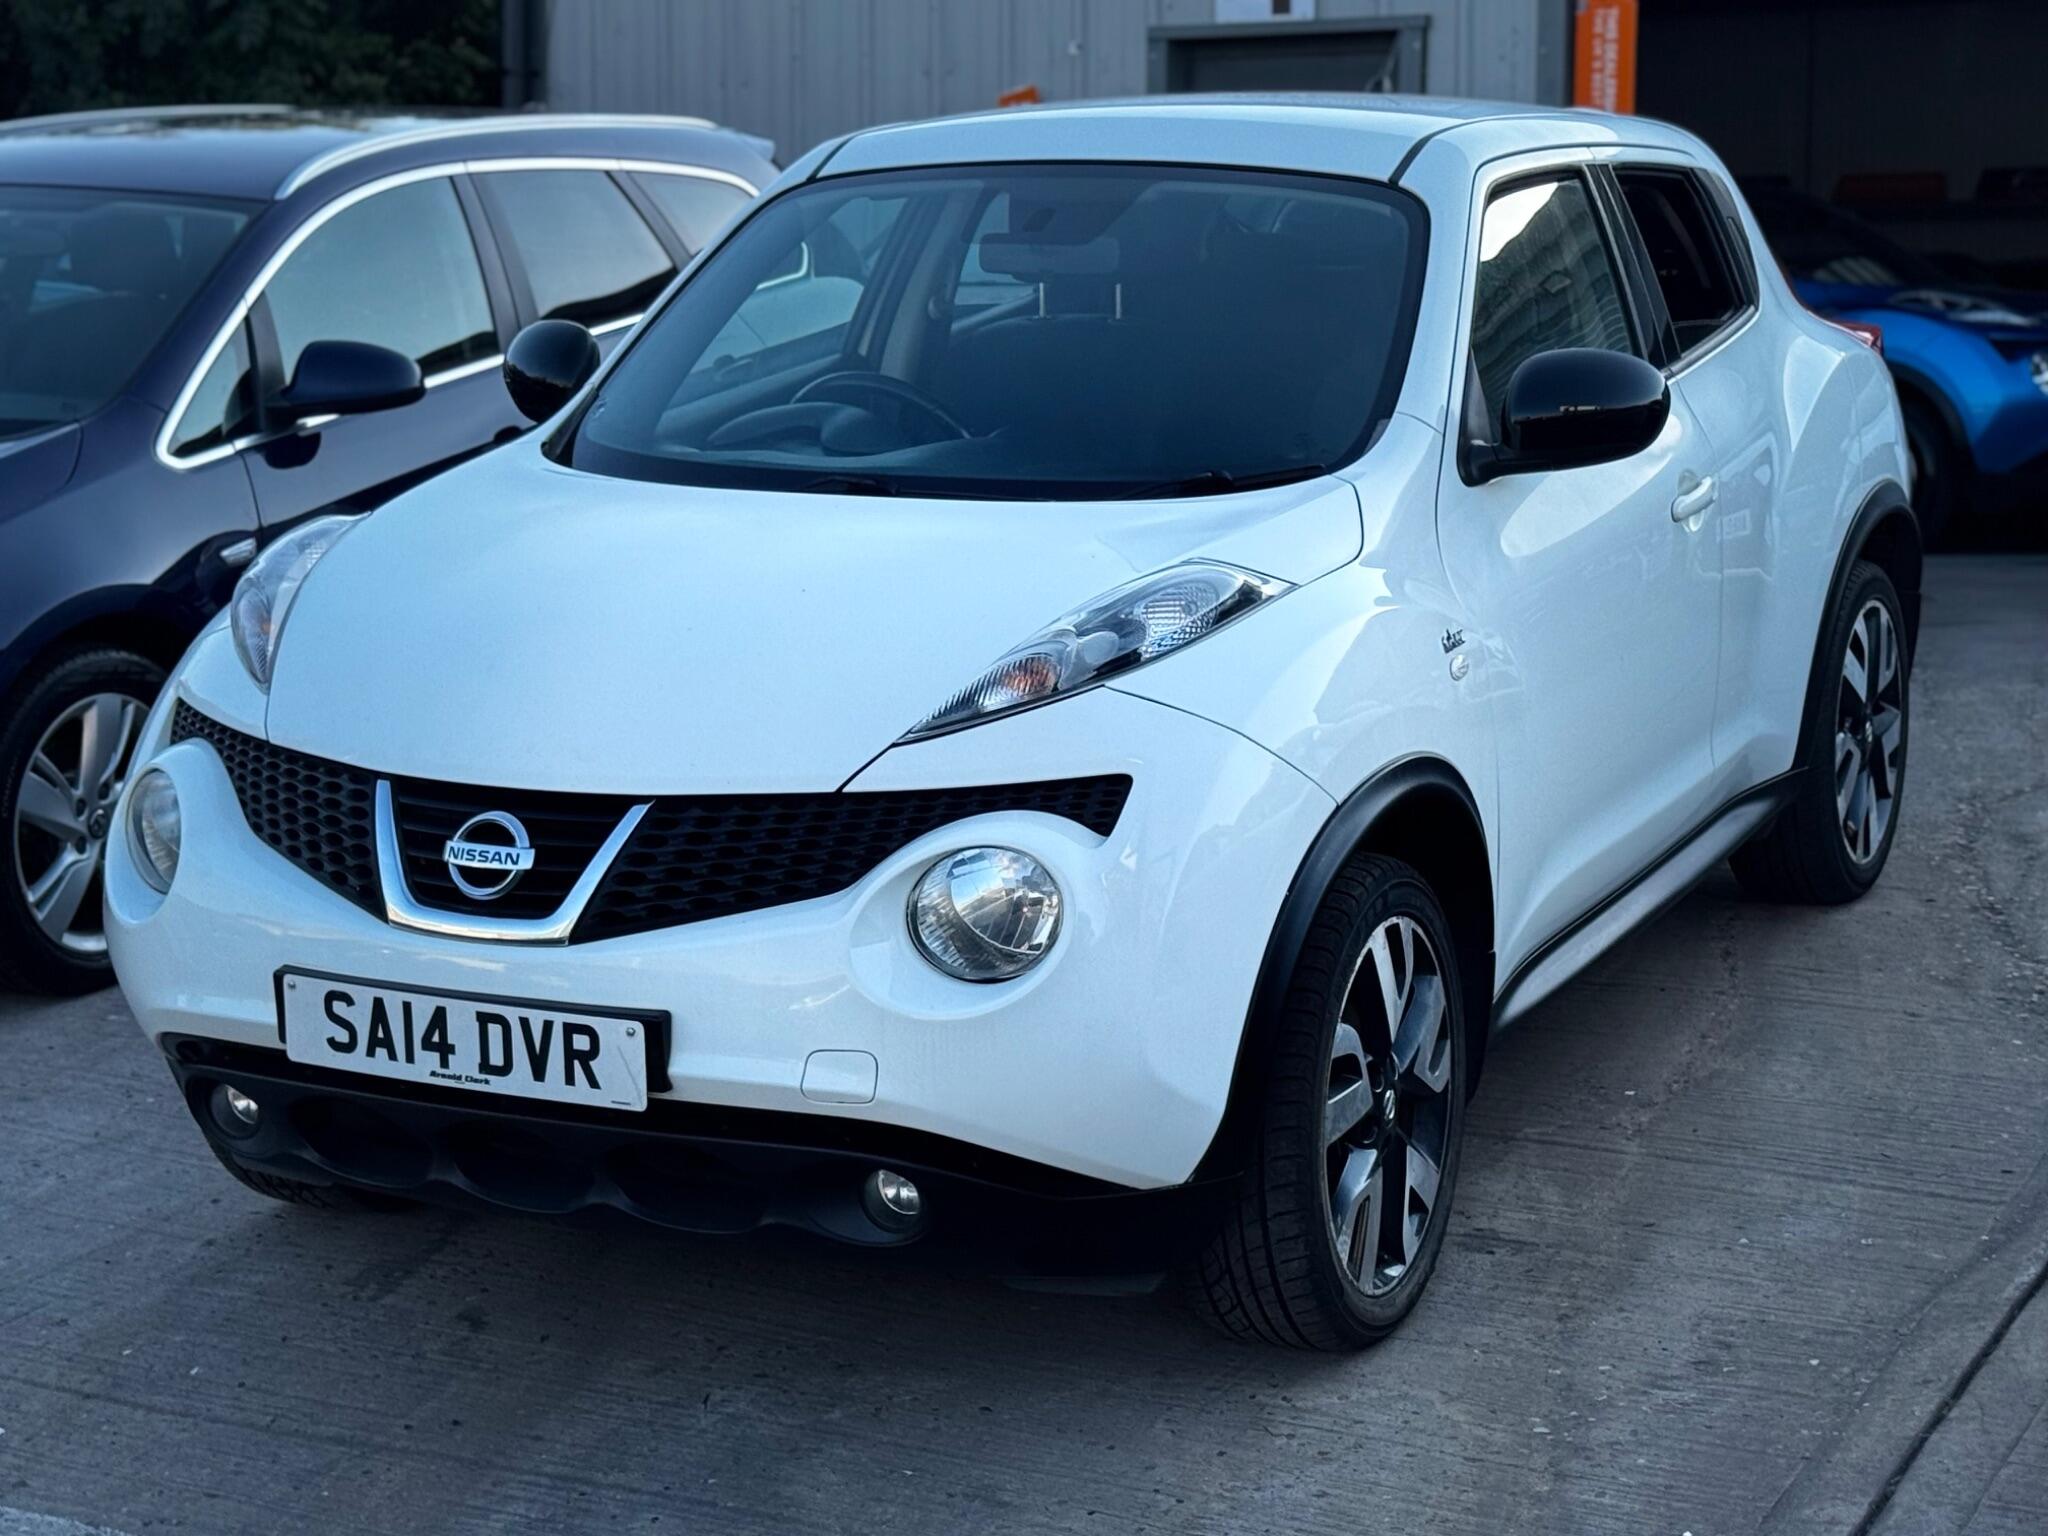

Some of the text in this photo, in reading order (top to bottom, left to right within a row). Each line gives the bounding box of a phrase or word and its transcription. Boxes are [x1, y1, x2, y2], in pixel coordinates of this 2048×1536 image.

[448, 846, 520, 866] NISSAN
[323, 989, 602, 1090] SA14 DVR
[429, 1070, 491, 1085] Arnold Clark
